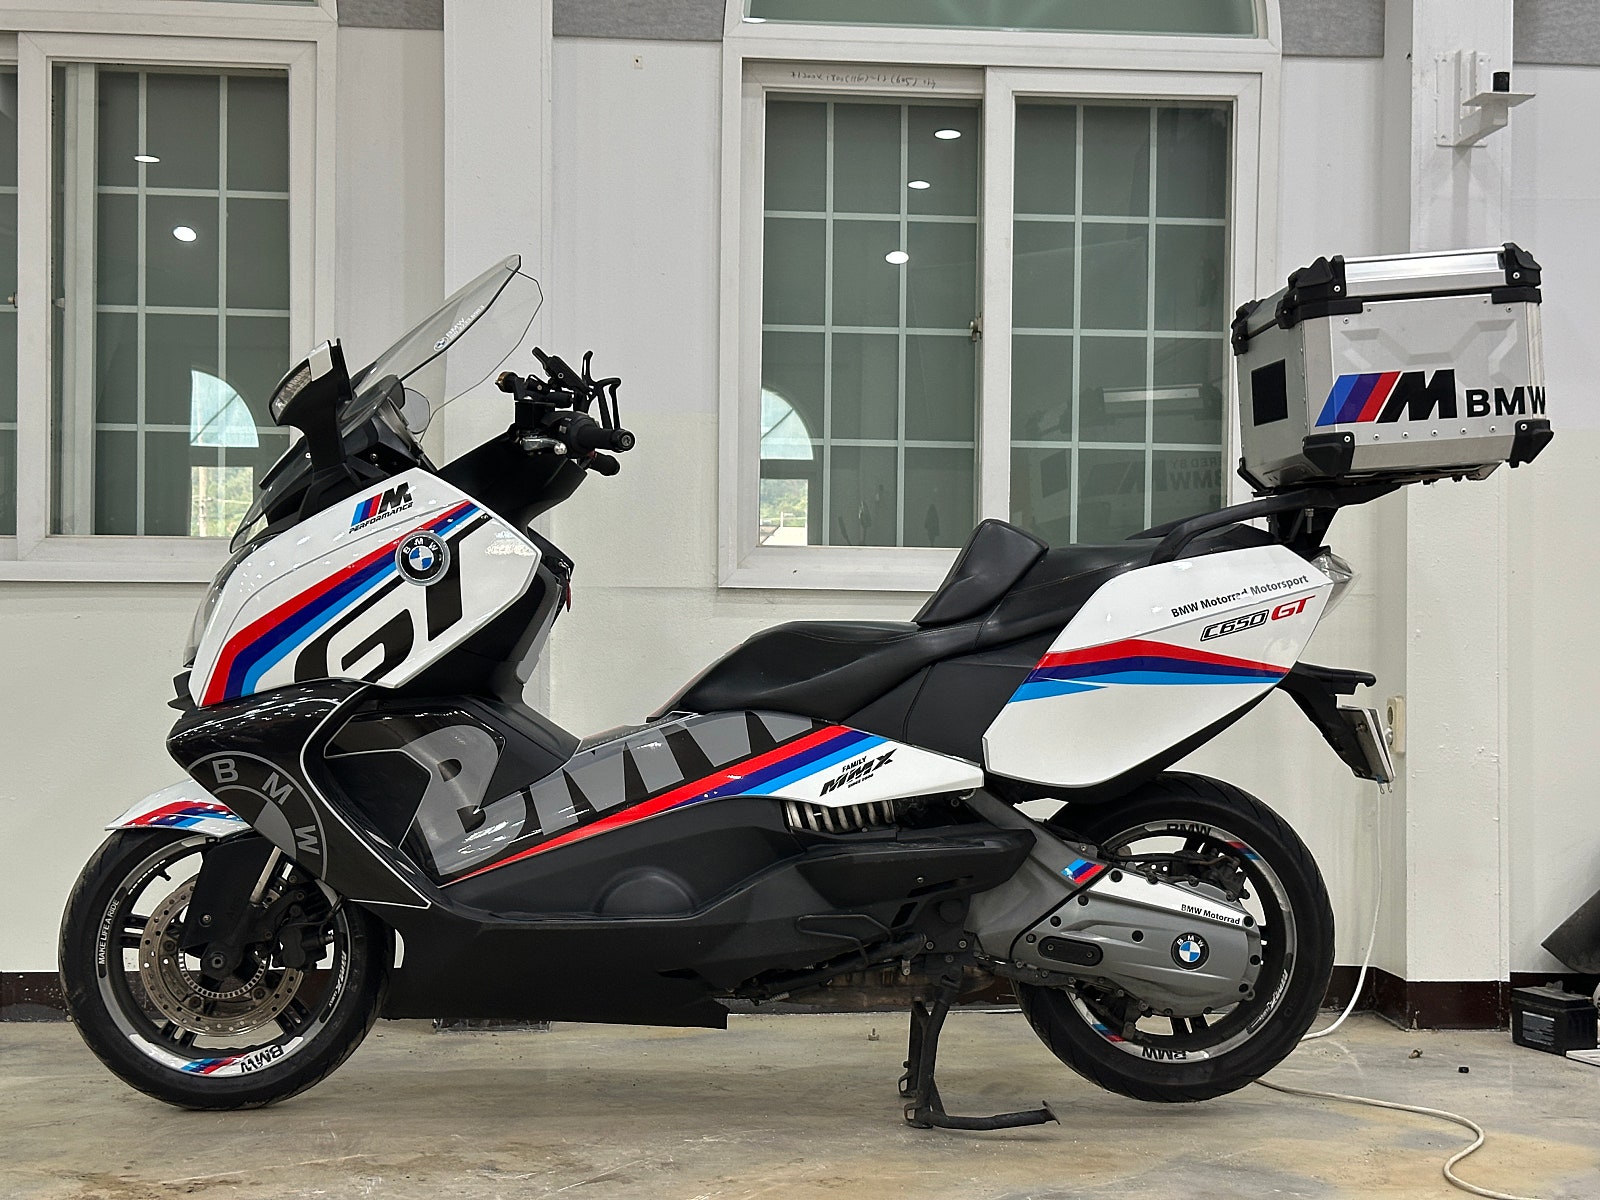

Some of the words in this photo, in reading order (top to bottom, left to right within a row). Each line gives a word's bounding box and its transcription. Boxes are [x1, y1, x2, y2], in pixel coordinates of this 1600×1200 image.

[1466, 386, 1545, 418] BMW
[349, 502, 414, 534] PERFORMANCE
[402, 537, 439, 554] BMW
[1171, 604, 1199, 618] BMW
[1250, 574, 1309, 596] Motorsport
[1201, 609, 1269, 641] C650
[1271, 595, 1316, 621] GT
[842, 756, 867, 773] FAMILY
[400, 711, 812, 877] BMW
[212, 758, 320, 855] BMW
[107, 899, 120, 918] RIDE
[1181, 903, 1203, 915] BMW
[1203, 909, 1241, 925] Motorrad
[100, 923, 110, 941] LIFE
[1176, 935, 1205, 948] BMW
[98, 941, 106, 965] MAKE
[240, 1044, 284, 1073] BMW
[1142, 1046, 1187, 1060] BMW
